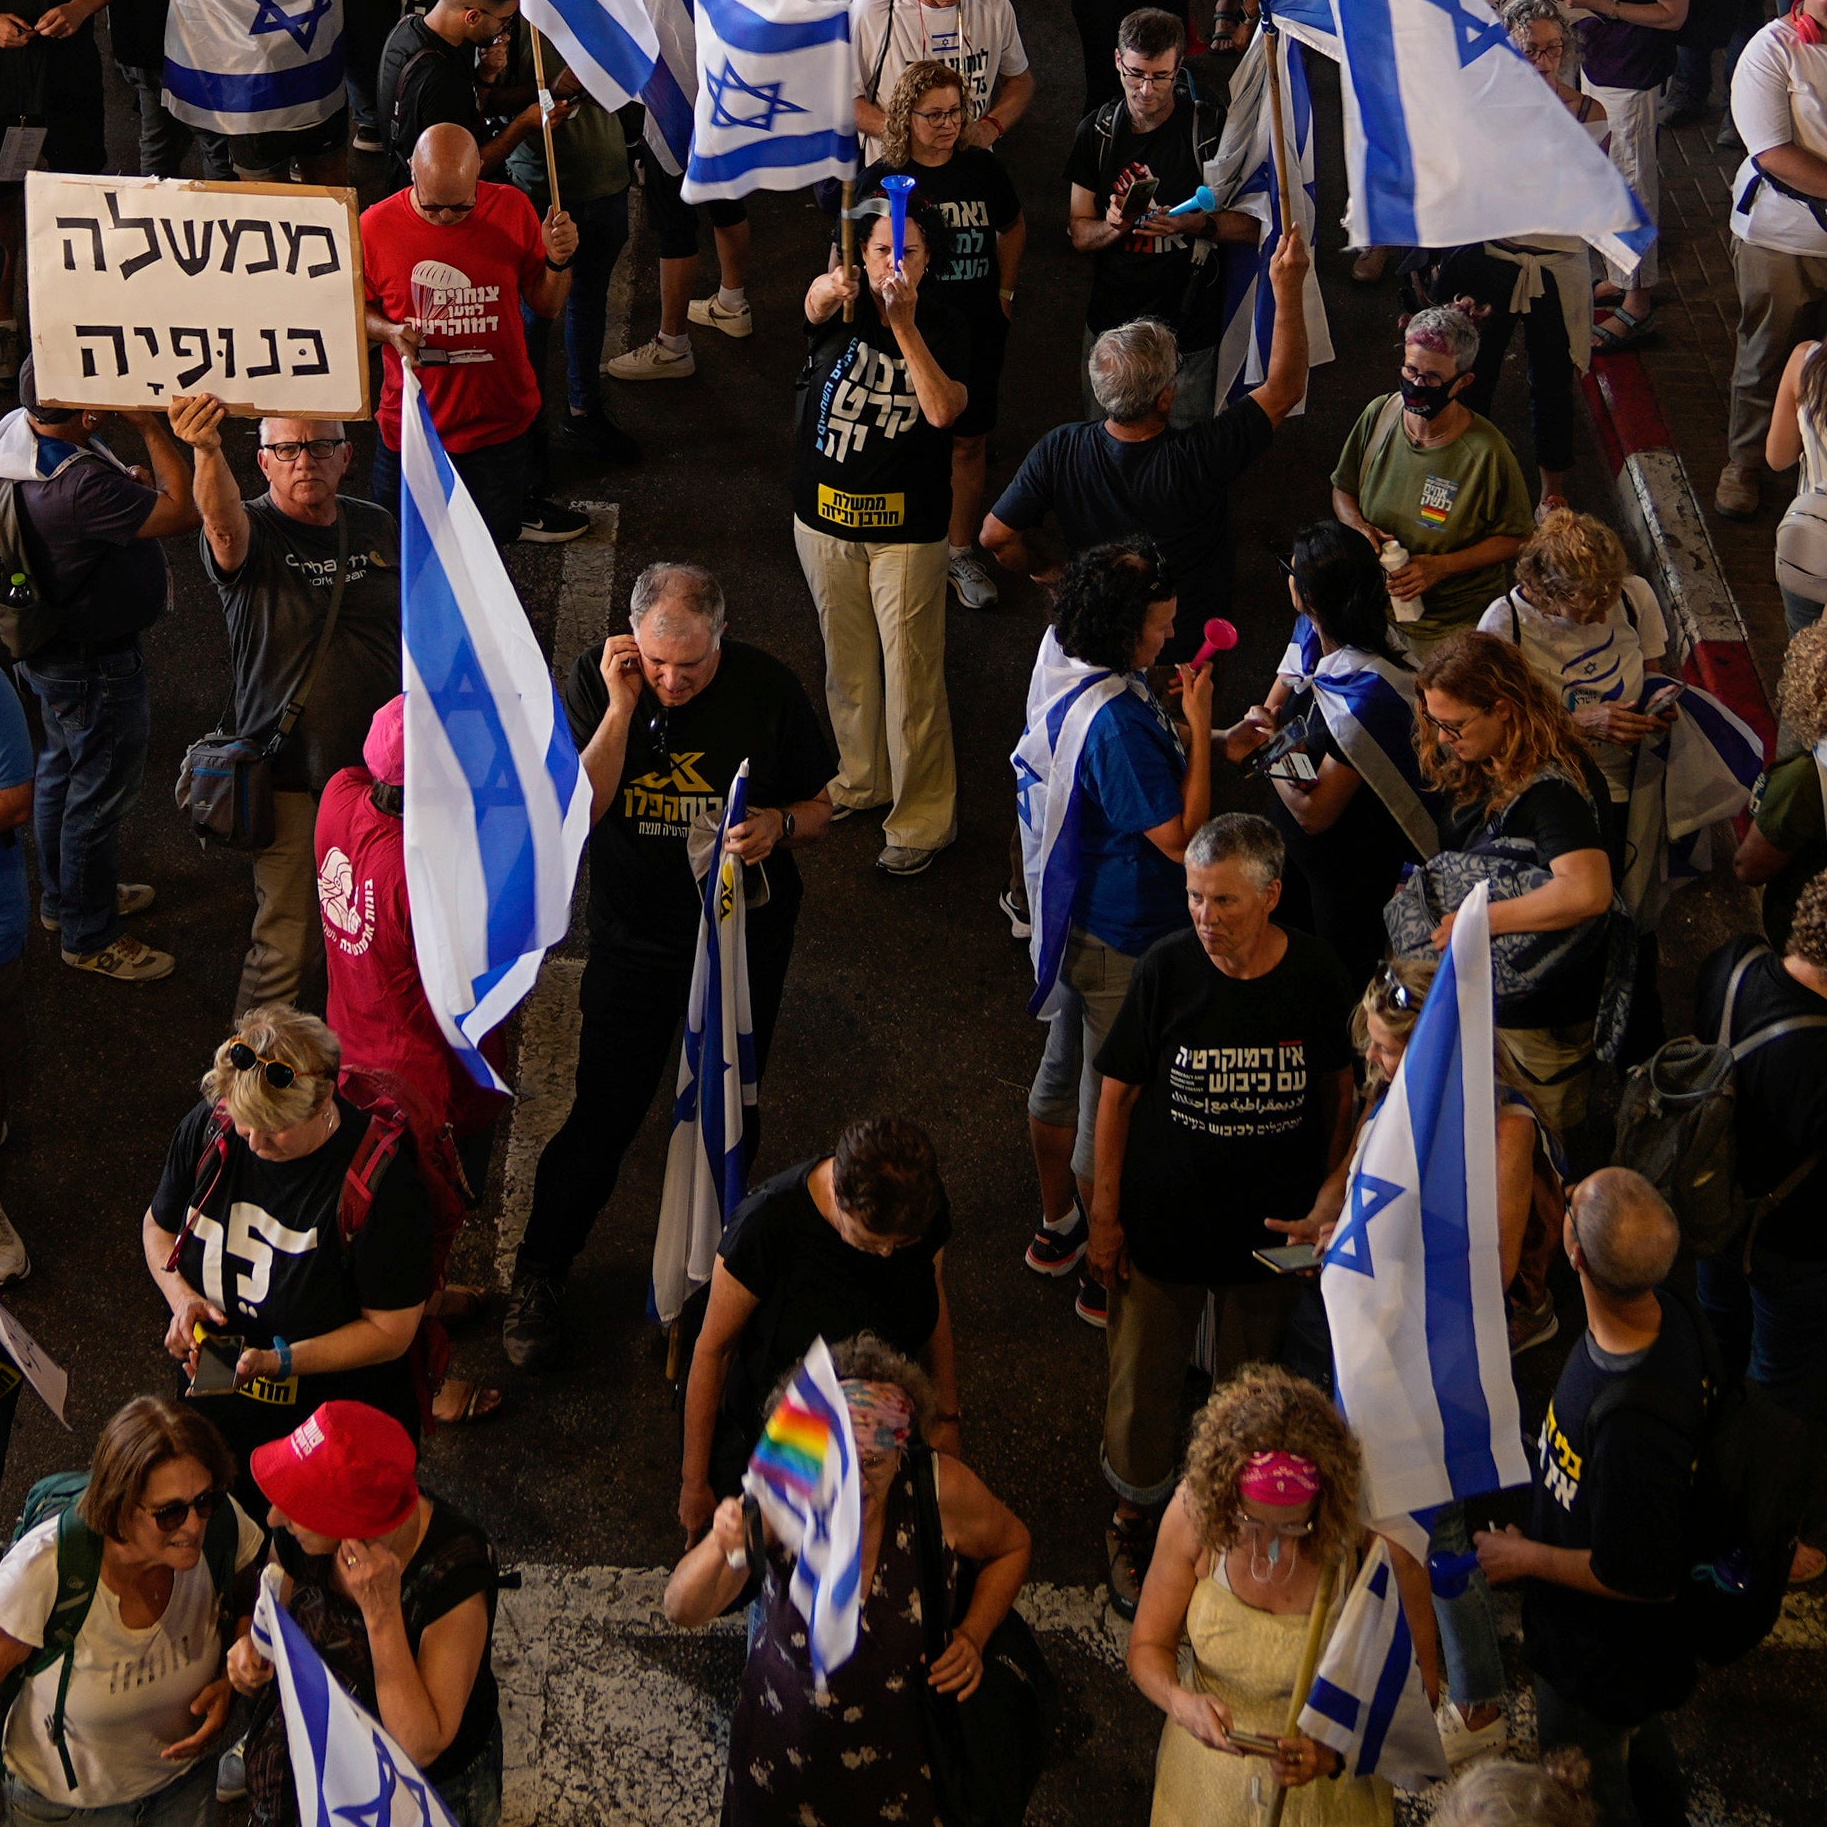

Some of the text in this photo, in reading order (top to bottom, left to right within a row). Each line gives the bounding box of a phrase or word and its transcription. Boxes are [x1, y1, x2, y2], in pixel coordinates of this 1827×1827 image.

[56, 192, 342, 280] ממשלה
[433, 286, 500, 307] צנחנים
[448, 301, 485, 319] למען
[829, 491, 887, 510] ממשלת
[820, 506, 900, 527] חורבן וביזה
[1174, 1045, 1306, 1071] אין דמוקרטיה
[1208, 1070, 1307, 1094] עם כיבוש
